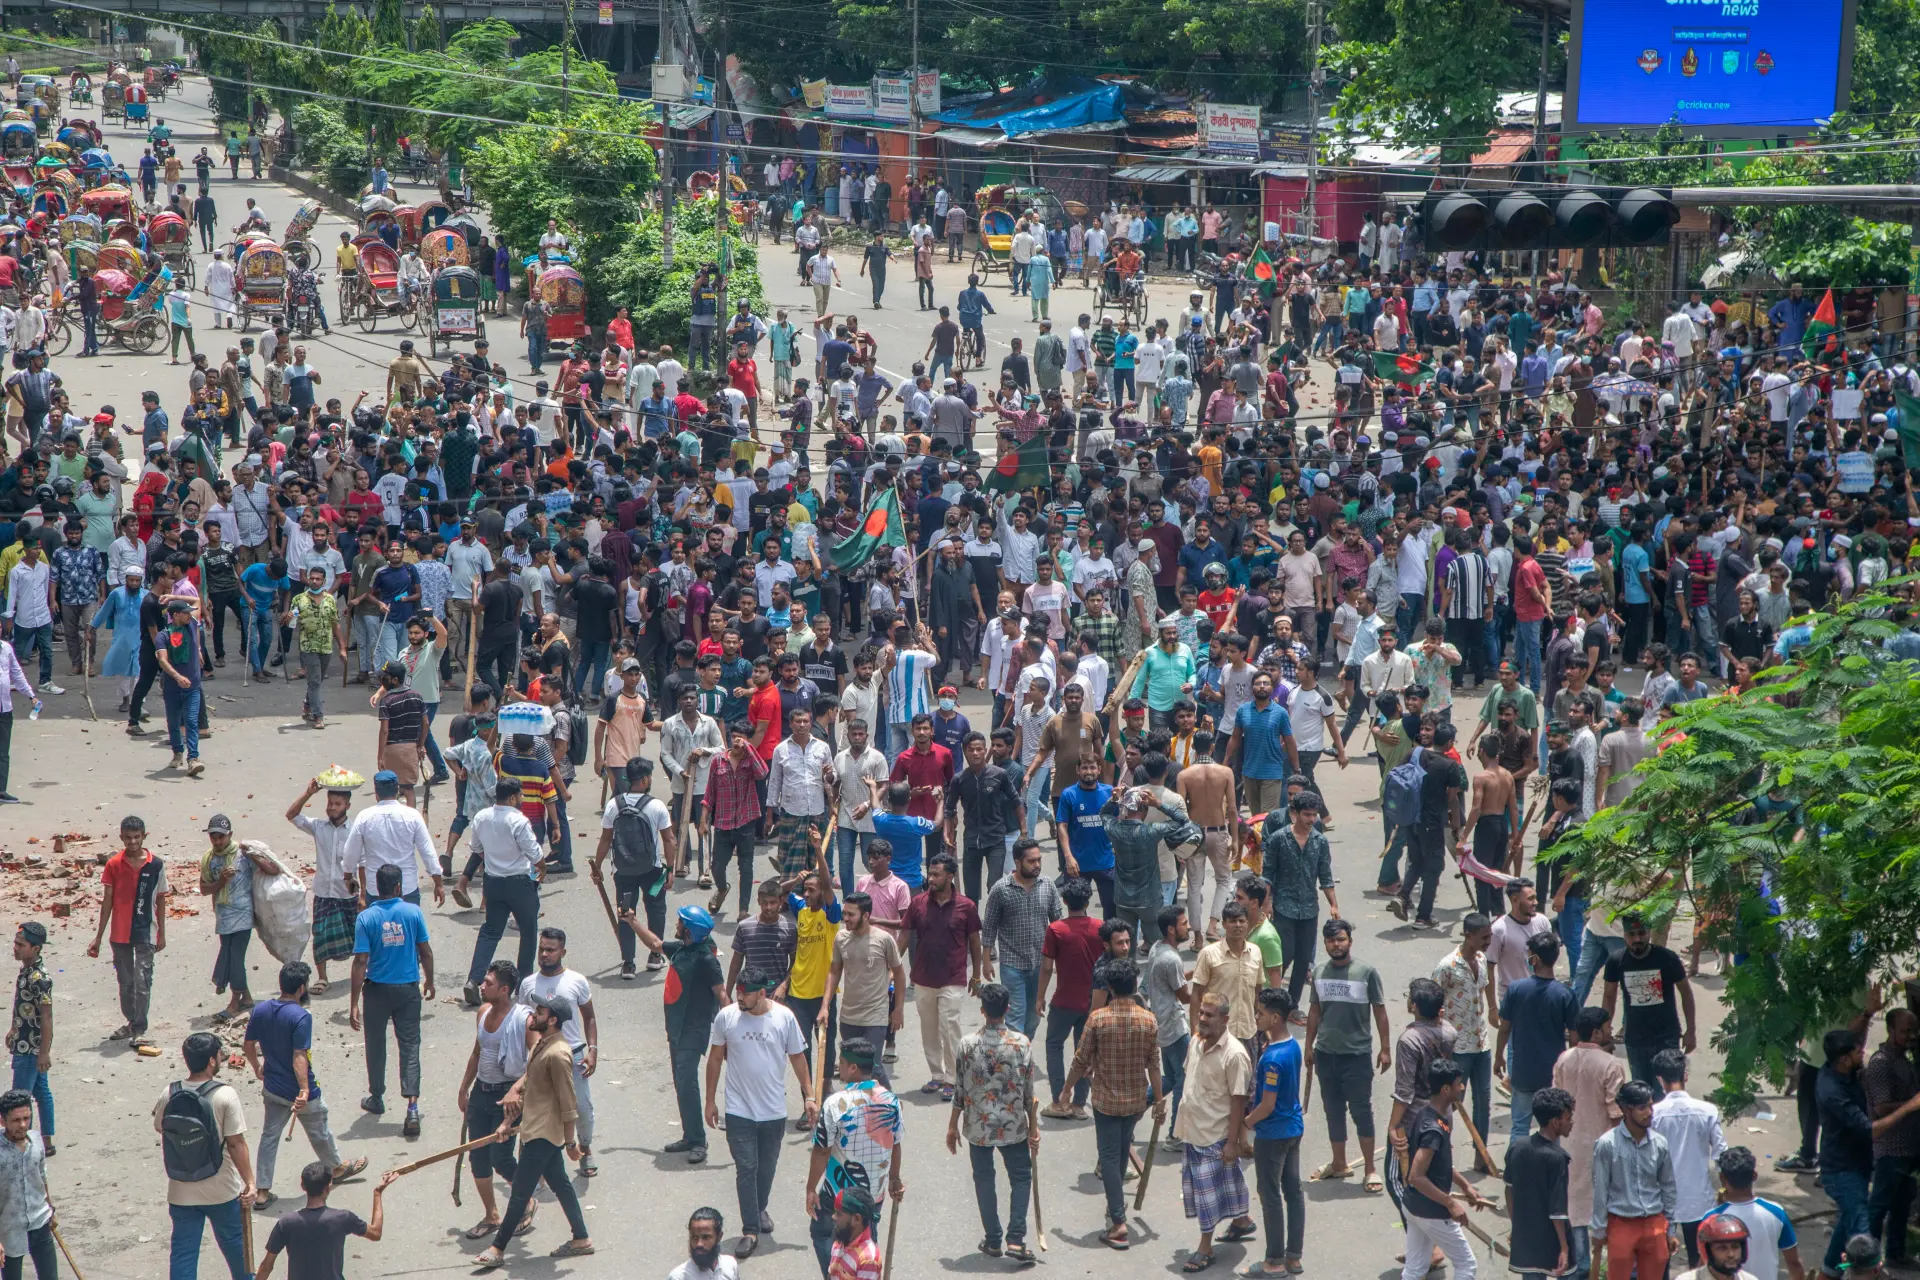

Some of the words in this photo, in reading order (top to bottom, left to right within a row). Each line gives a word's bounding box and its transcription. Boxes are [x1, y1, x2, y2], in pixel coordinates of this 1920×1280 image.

[1721, 4, 1759, 17] news
[1209, 112, 1229, 127] করবী
[802, 691, 808, 699] 9
[1323, 982, 1351, 997] VANS
